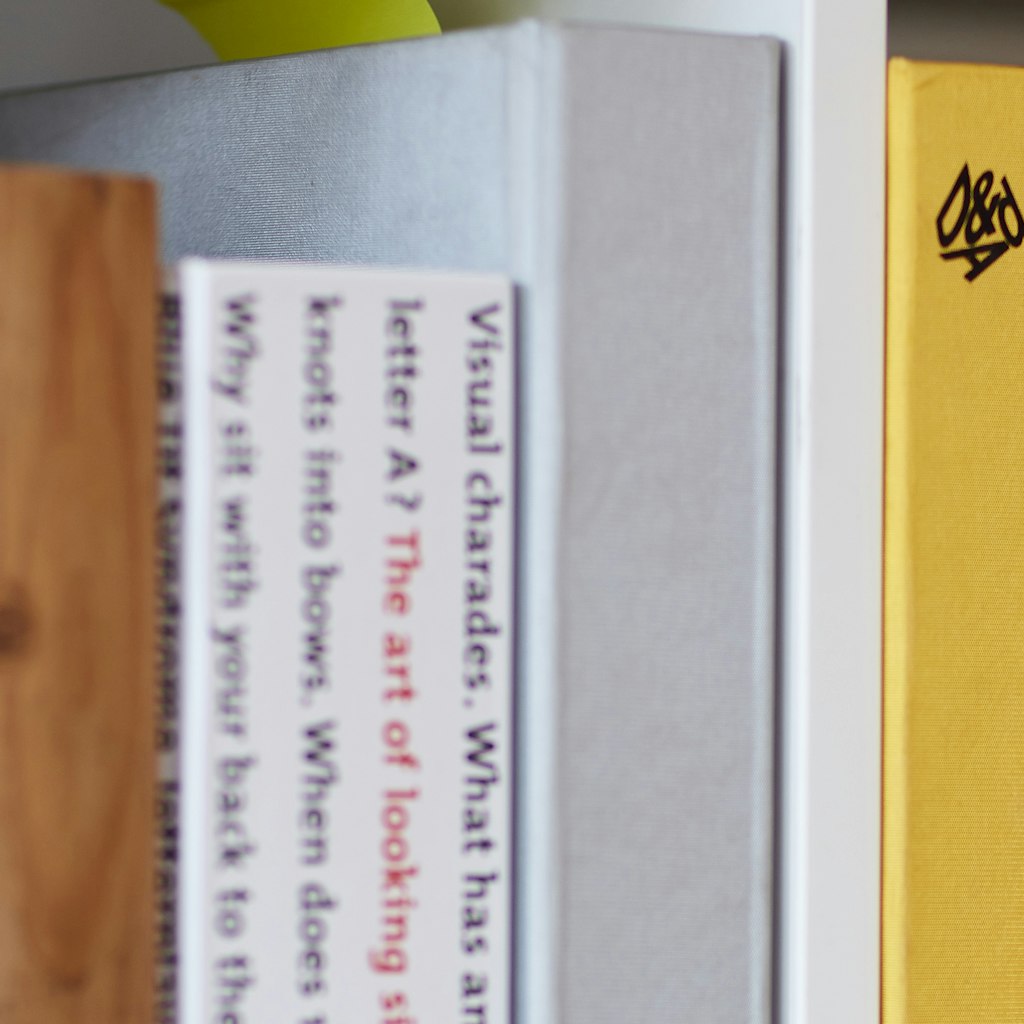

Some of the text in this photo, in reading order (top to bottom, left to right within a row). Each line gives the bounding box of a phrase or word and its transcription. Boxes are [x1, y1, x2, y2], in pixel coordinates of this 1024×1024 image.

[210, 294, 258, 404] Why
[303, 294, 343, 432] knots
[385, 299, 424, 433] letter
[466, 303, 502, 454] Visual
[222, 422, 255, 478] sit
[302, 449, 339, 549] into
[219, 497, 257, 609] with
[382, 531, 422, 616] The
[464, 471, 502, 708] charades.
[209, 627, 247, 738] your
[300, 564, 341, 707] bows.
[381, 633, 417, 702] art
[300, 720, 339, 866] When
[380, 720, 420, 770] of
[462, 722, 499, 852] What
[215, 756, 256, 868] back
[213, 886, 250, 939] to
[368, 788, 420, 974] looking
[461, 872, 498, 954] has
[298, 882, 338, 996] does
